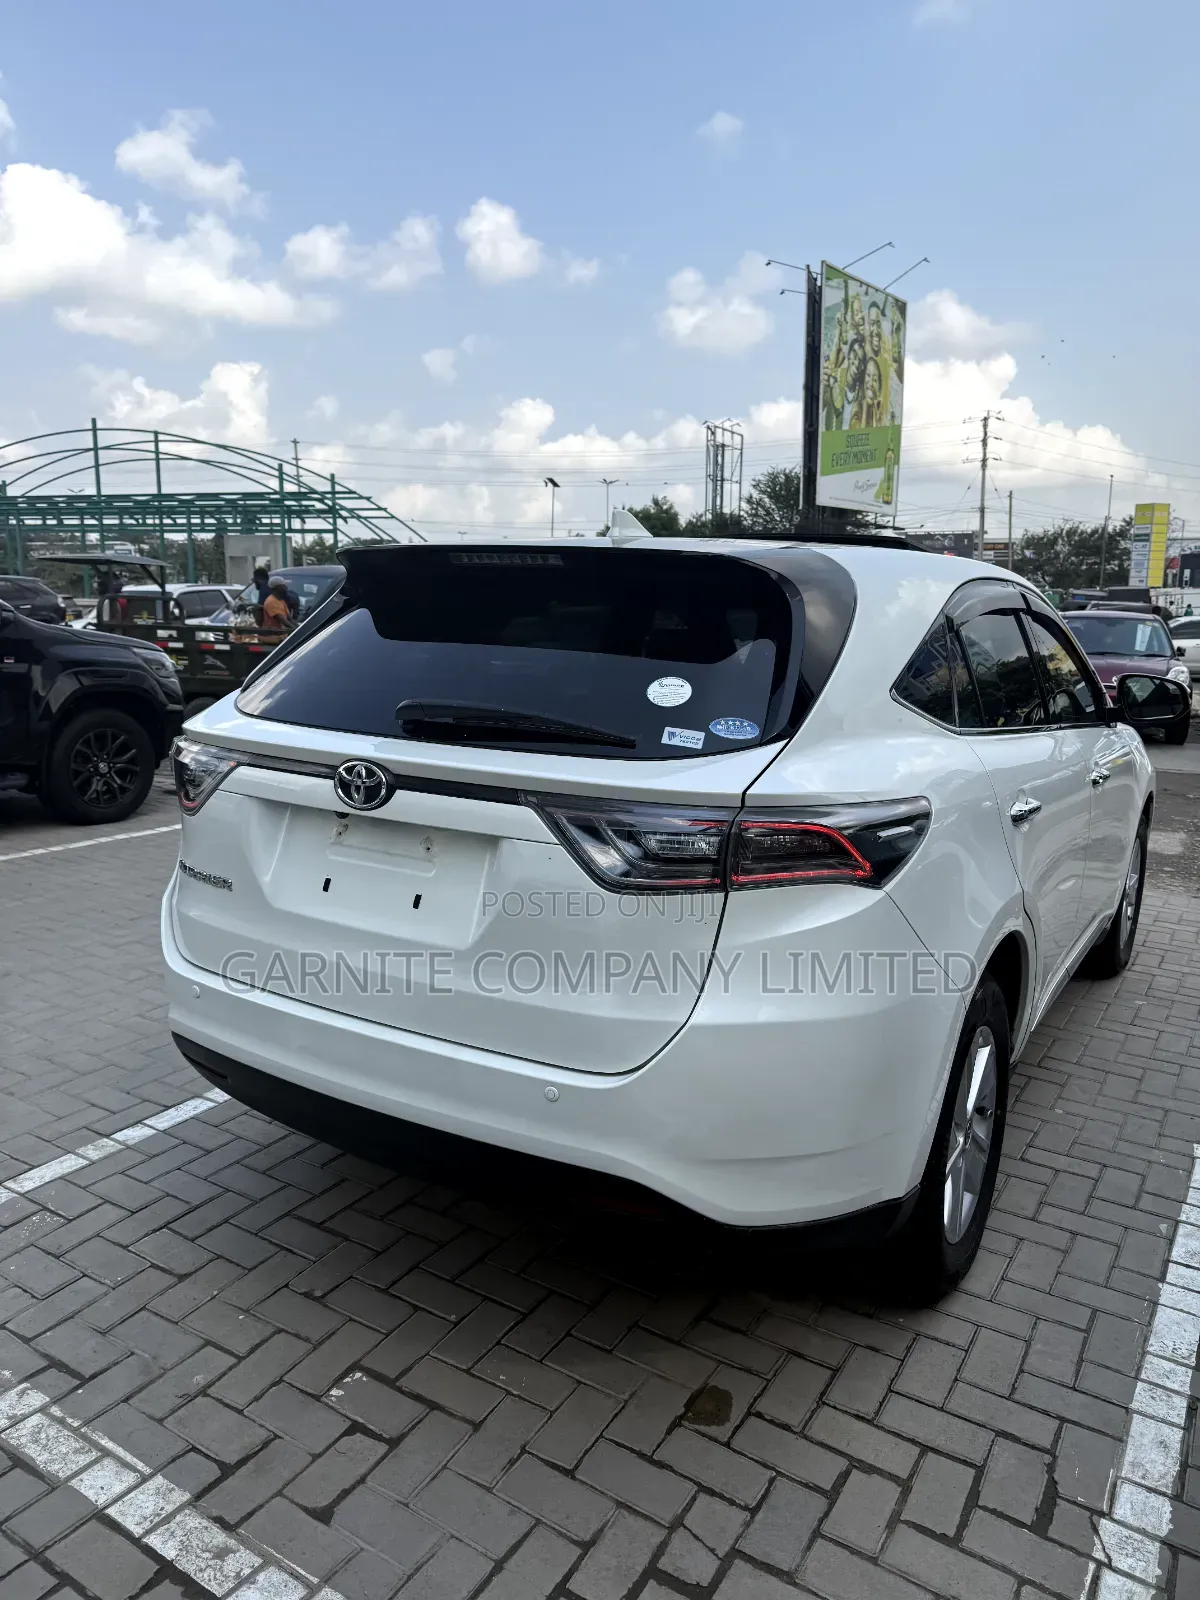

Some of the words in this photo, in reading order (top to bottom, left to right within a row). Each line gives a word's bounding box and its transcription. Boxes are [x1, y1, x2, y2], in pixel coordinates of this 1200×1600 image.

[846, 433, 870, 448] SQUEEZE
[831, 452, 851, 467] EVERY
[852, 449, 877, 464] MOMENT
